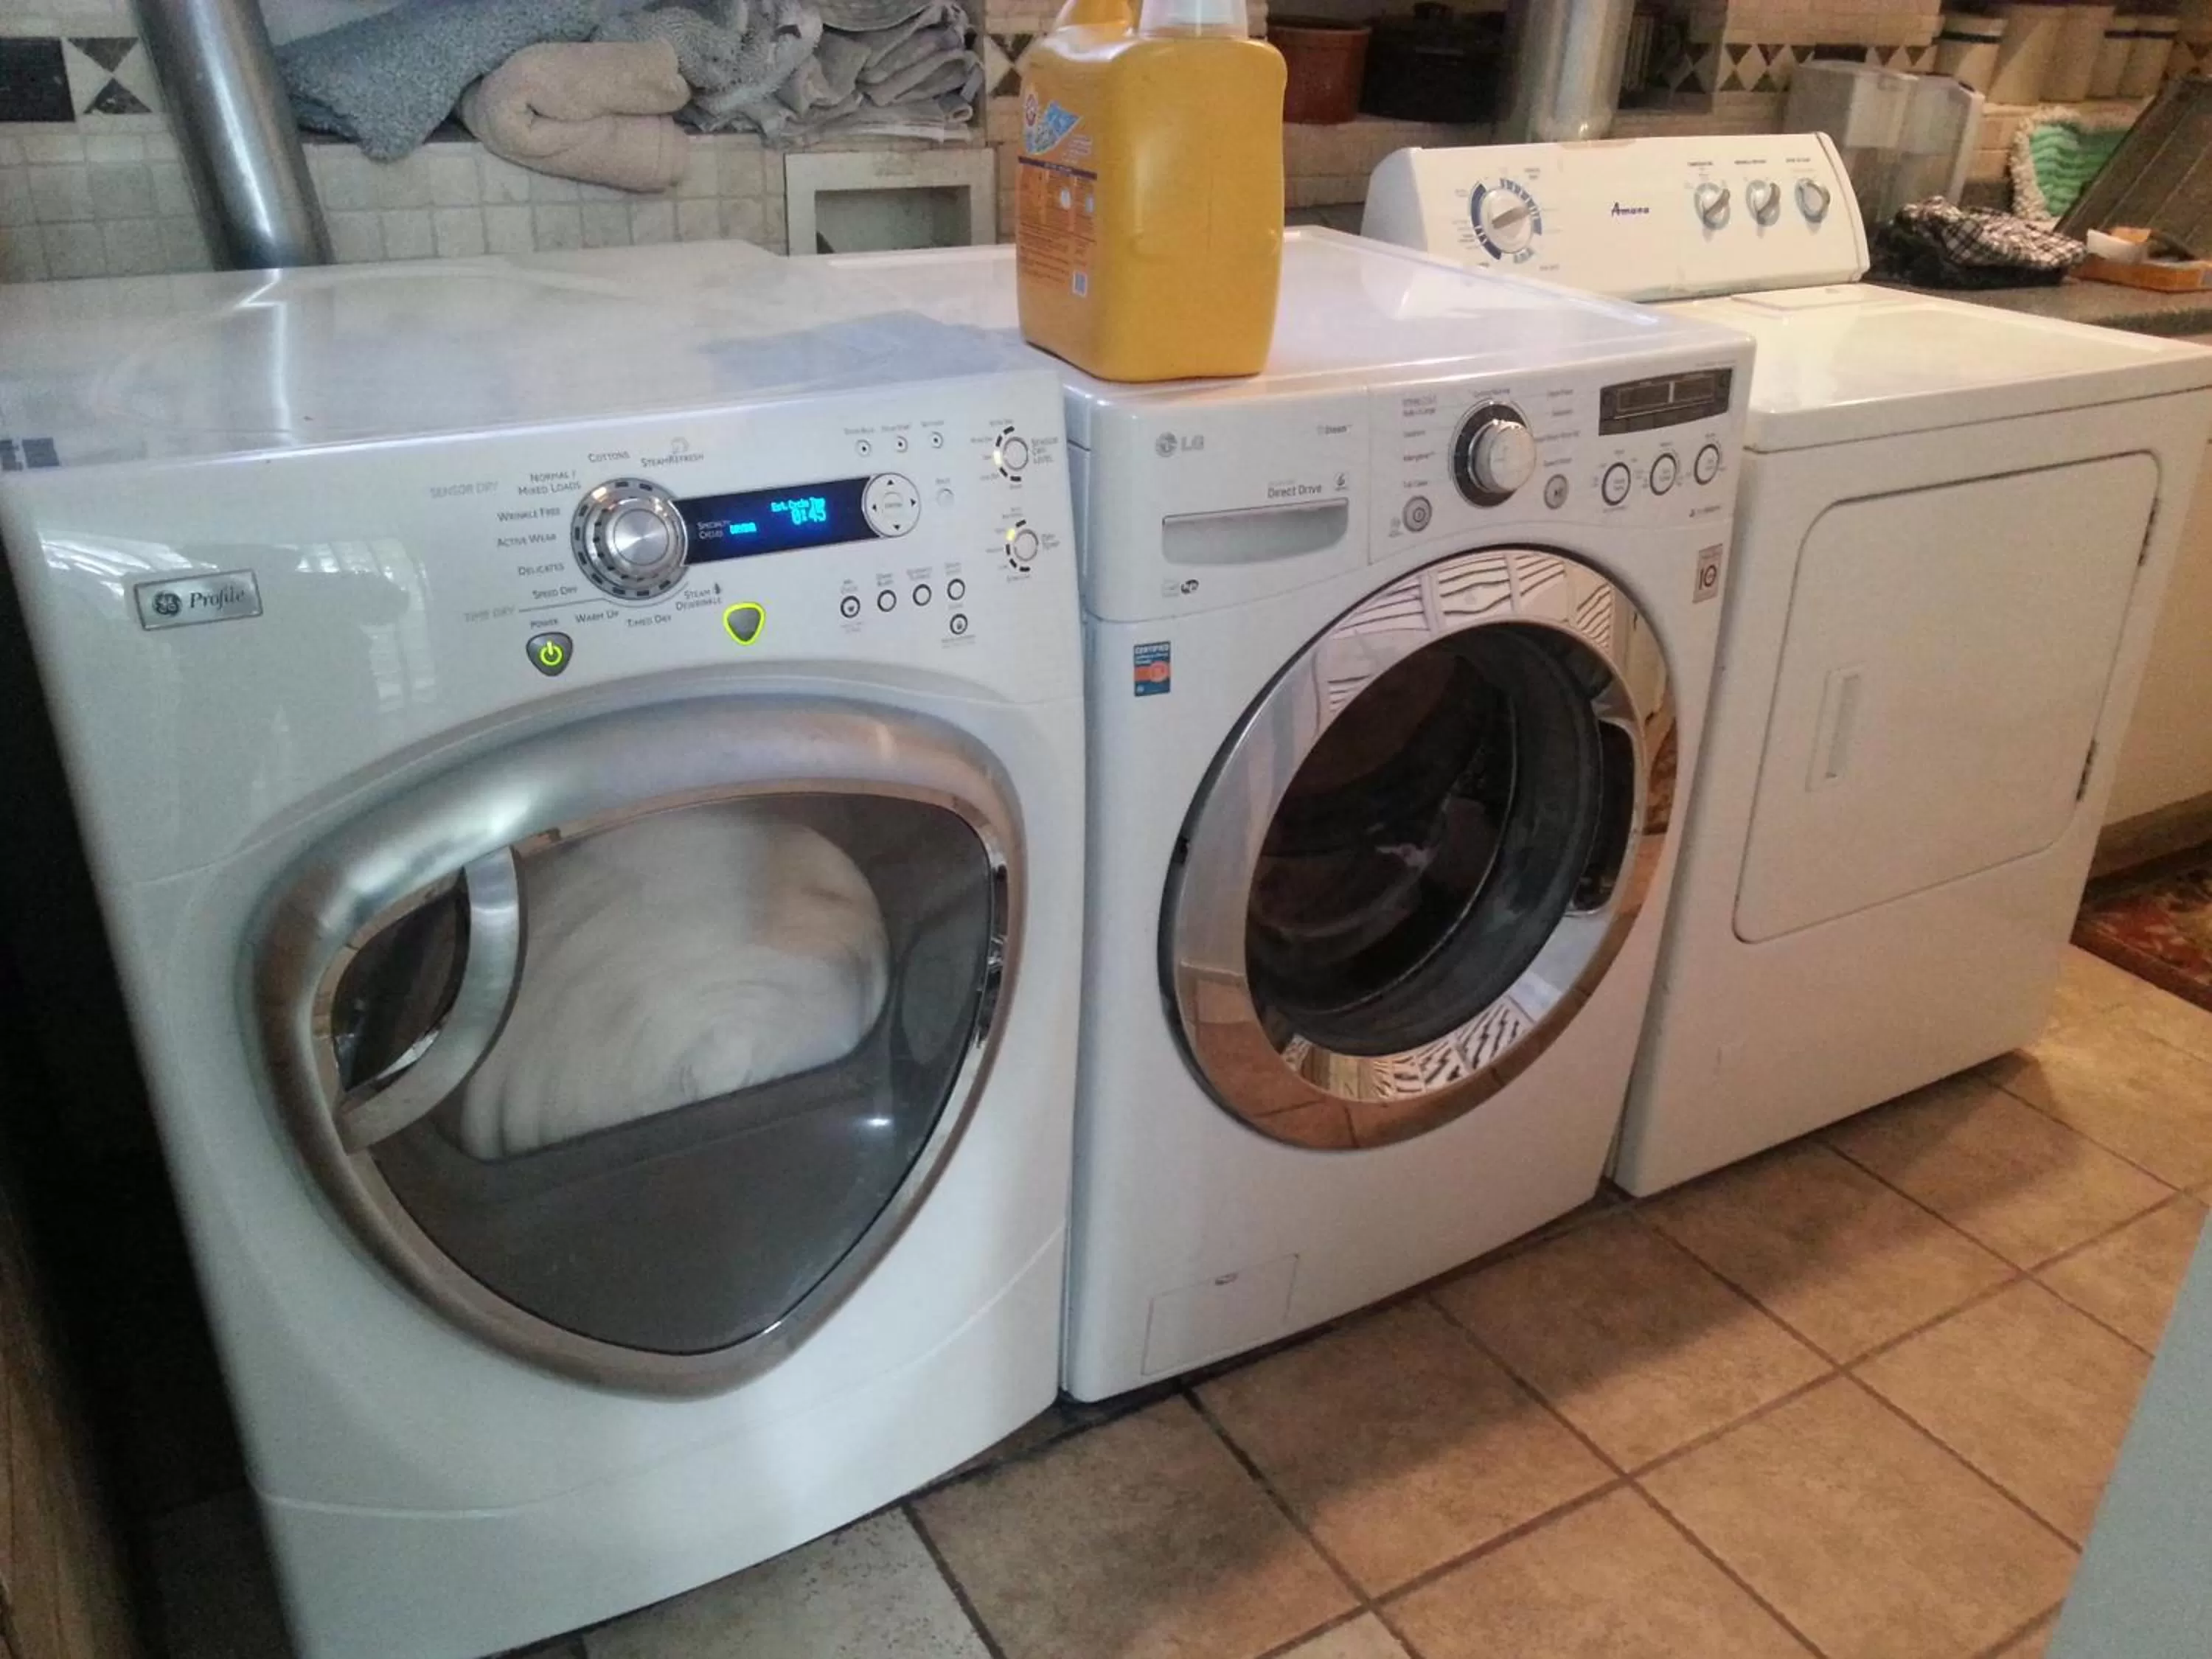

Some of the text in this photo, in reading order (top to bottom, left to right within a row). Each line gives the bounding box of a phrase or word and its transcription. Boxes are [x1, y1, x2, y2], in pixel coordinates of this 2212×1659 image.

[1611, 201, 1649, 218] Amana
[1180, 435, 1205, 451] LG
[1267, 484, 1322, 499] Direct Drive
[189, 585, 245, 611] Profile
